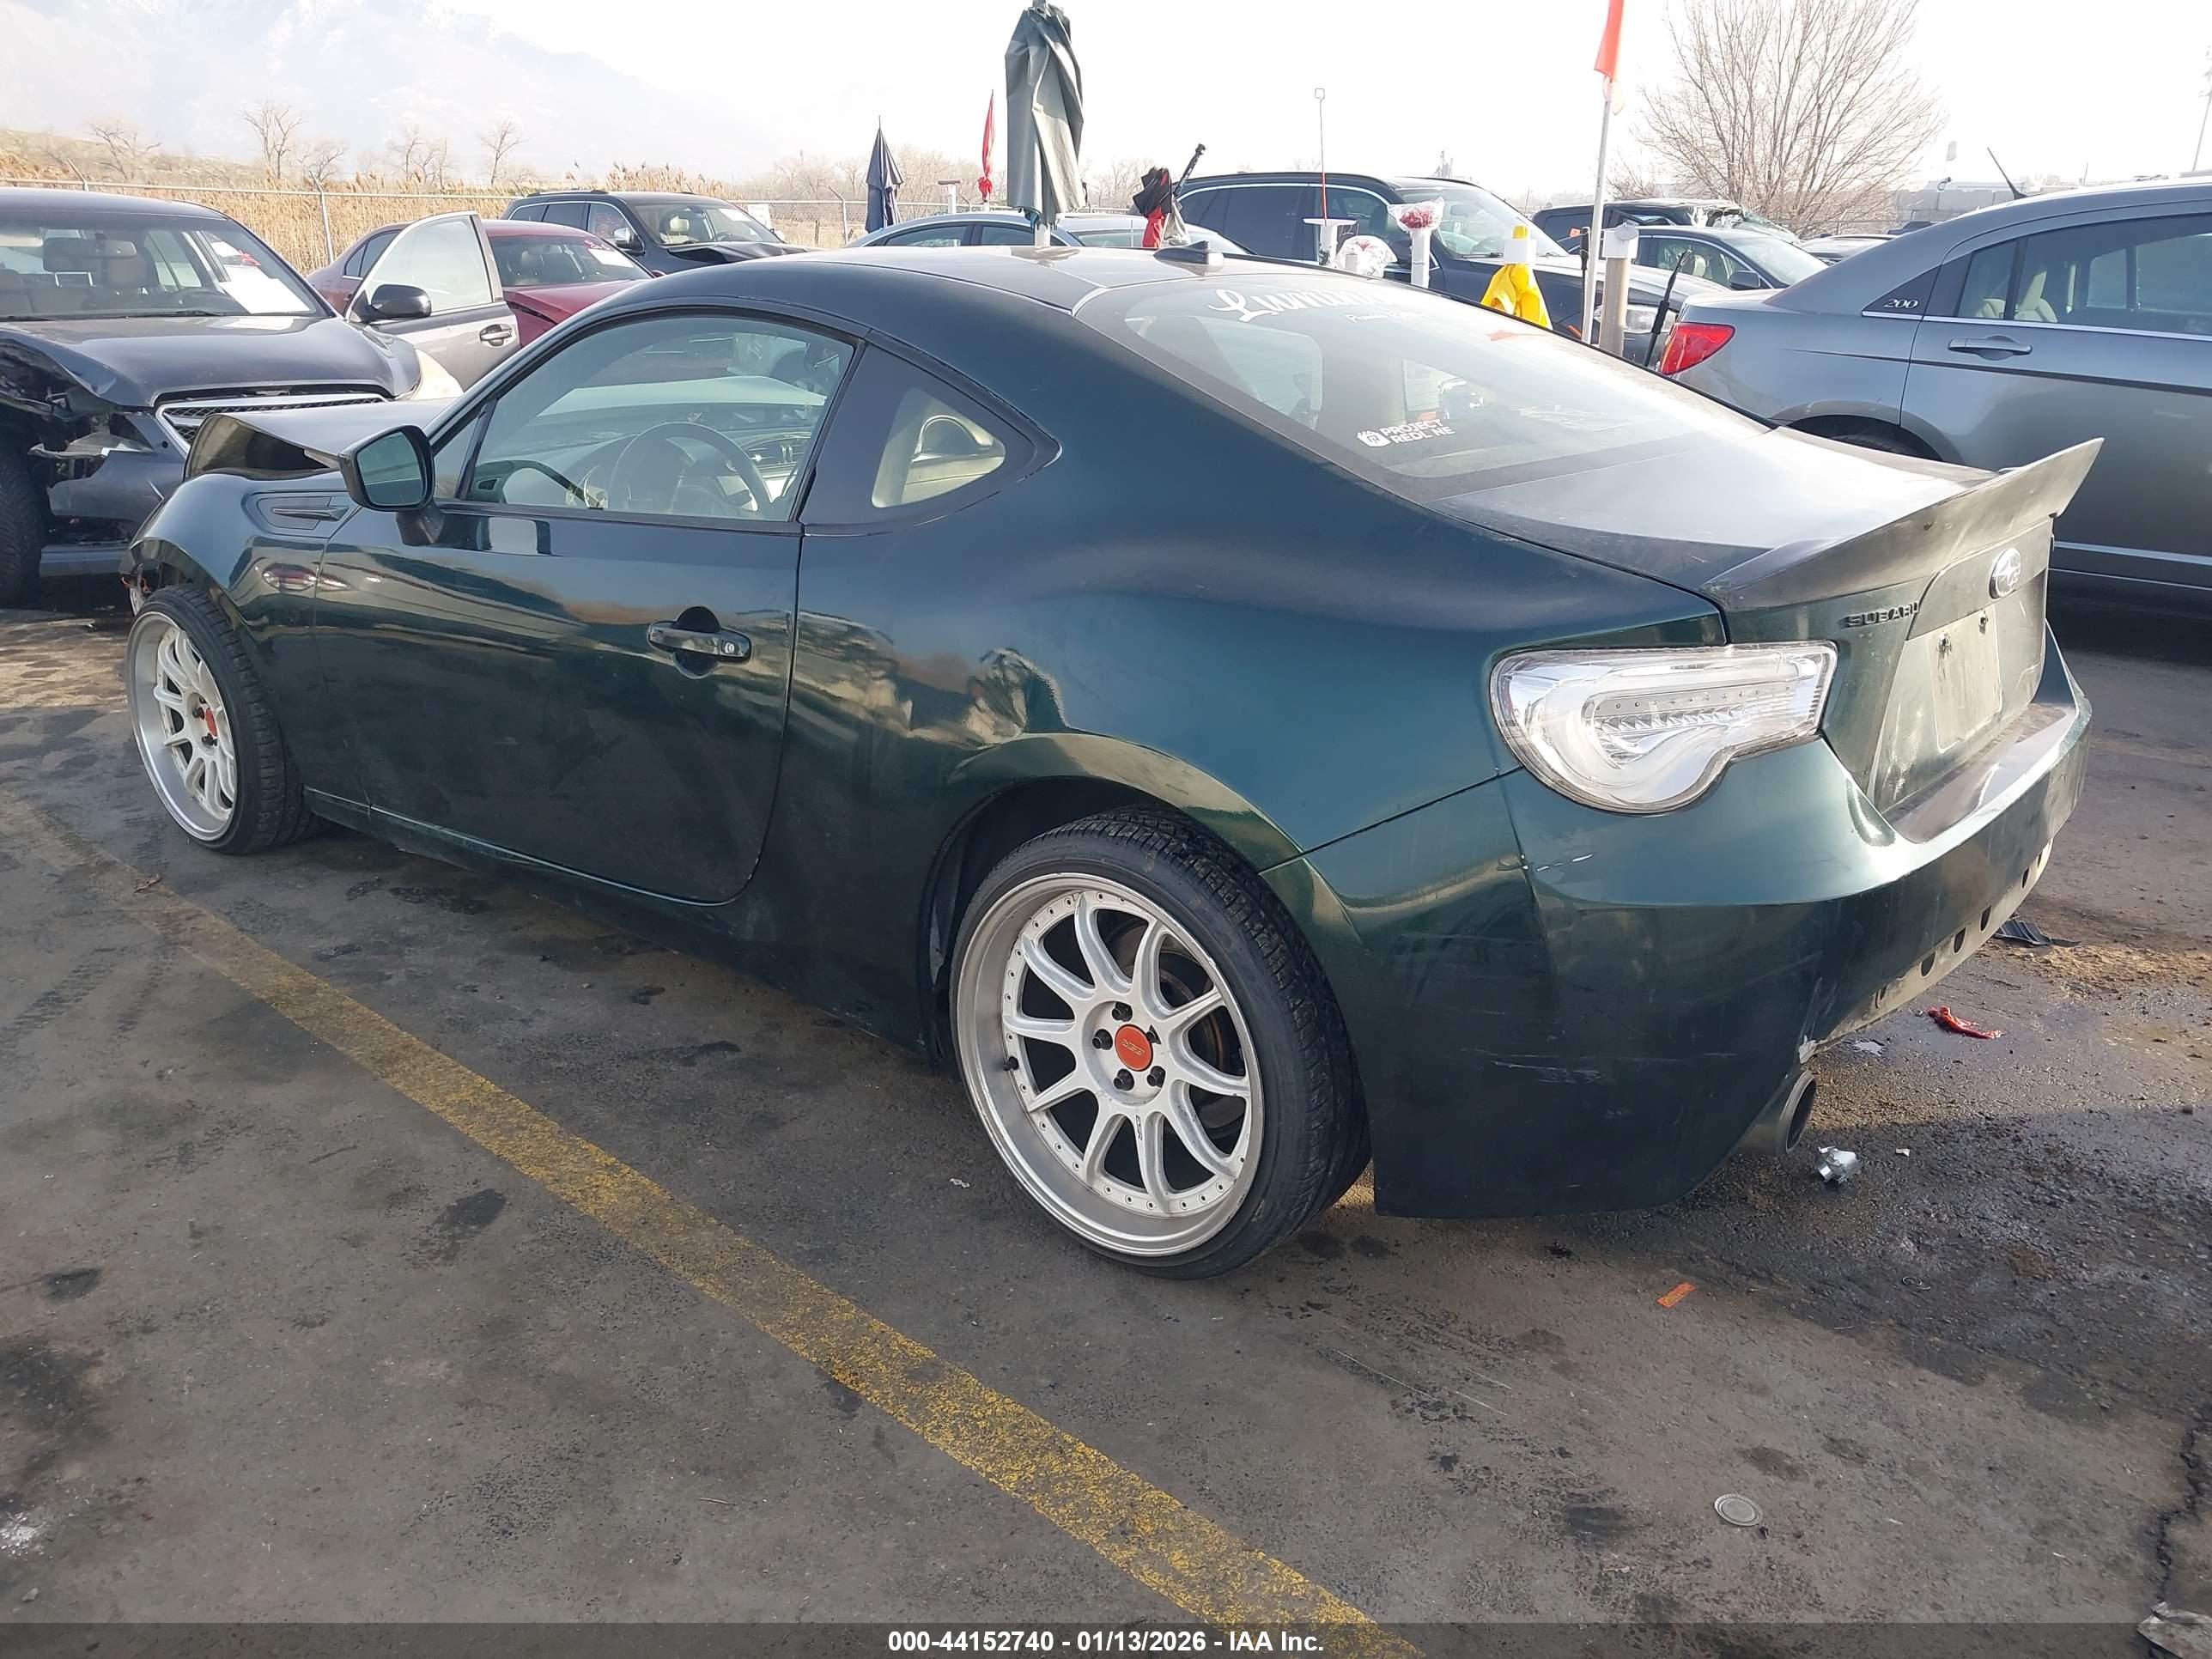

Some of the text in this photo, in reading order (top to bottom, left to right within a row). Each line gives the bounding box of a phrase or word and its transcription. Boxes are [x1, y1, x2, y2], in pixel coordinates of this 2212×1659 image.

[1883, 298, 1918, 309] 200
[1379, 418, 1443, 436] PROJECT
[1389, 426, 1455, 444] REDLNE
[1845, 602, 1919, 628] SUBARU
